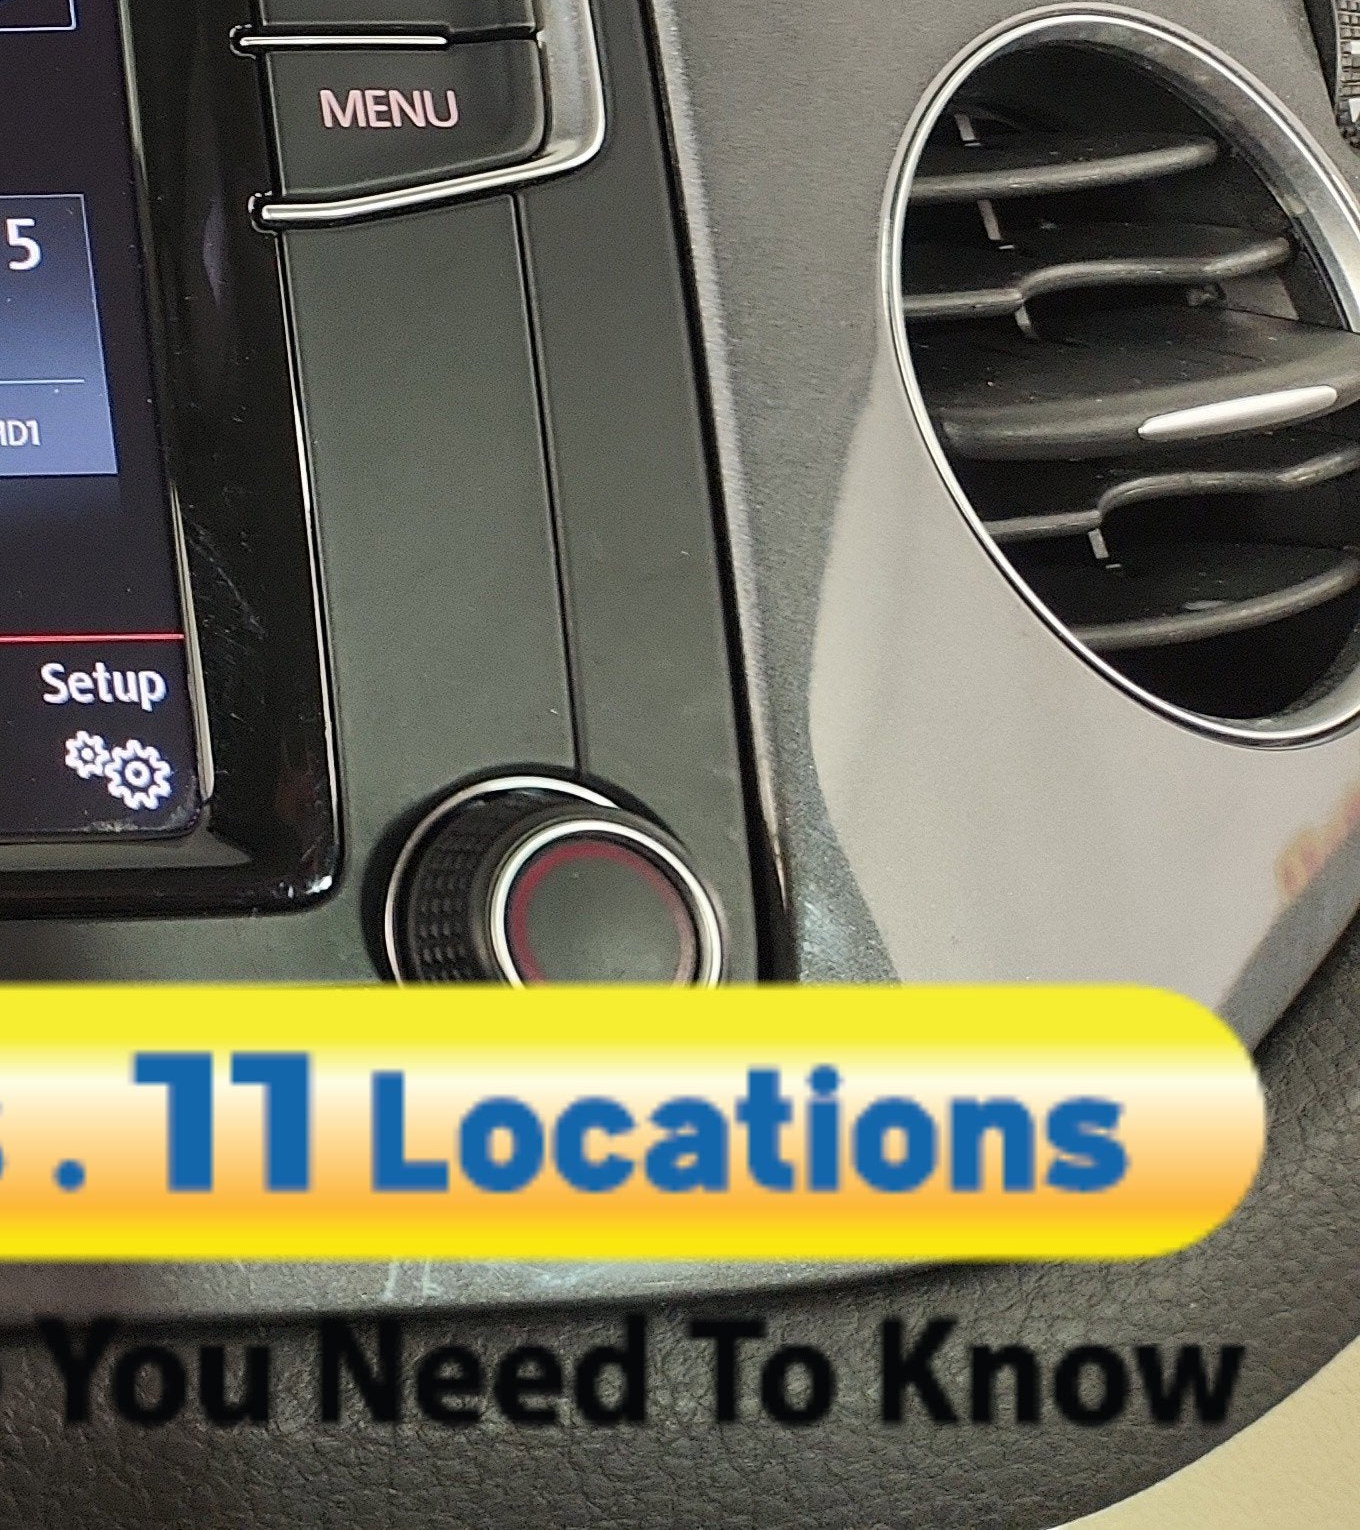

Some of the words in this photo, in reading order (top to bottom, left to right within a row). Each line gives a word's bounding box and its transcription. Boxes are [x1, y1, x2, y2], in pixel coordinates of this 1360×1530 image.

[319, 89, 459, 128] MENU
[6, 218, 41, 270] 5
[40, 662, 166, 712] Setup
